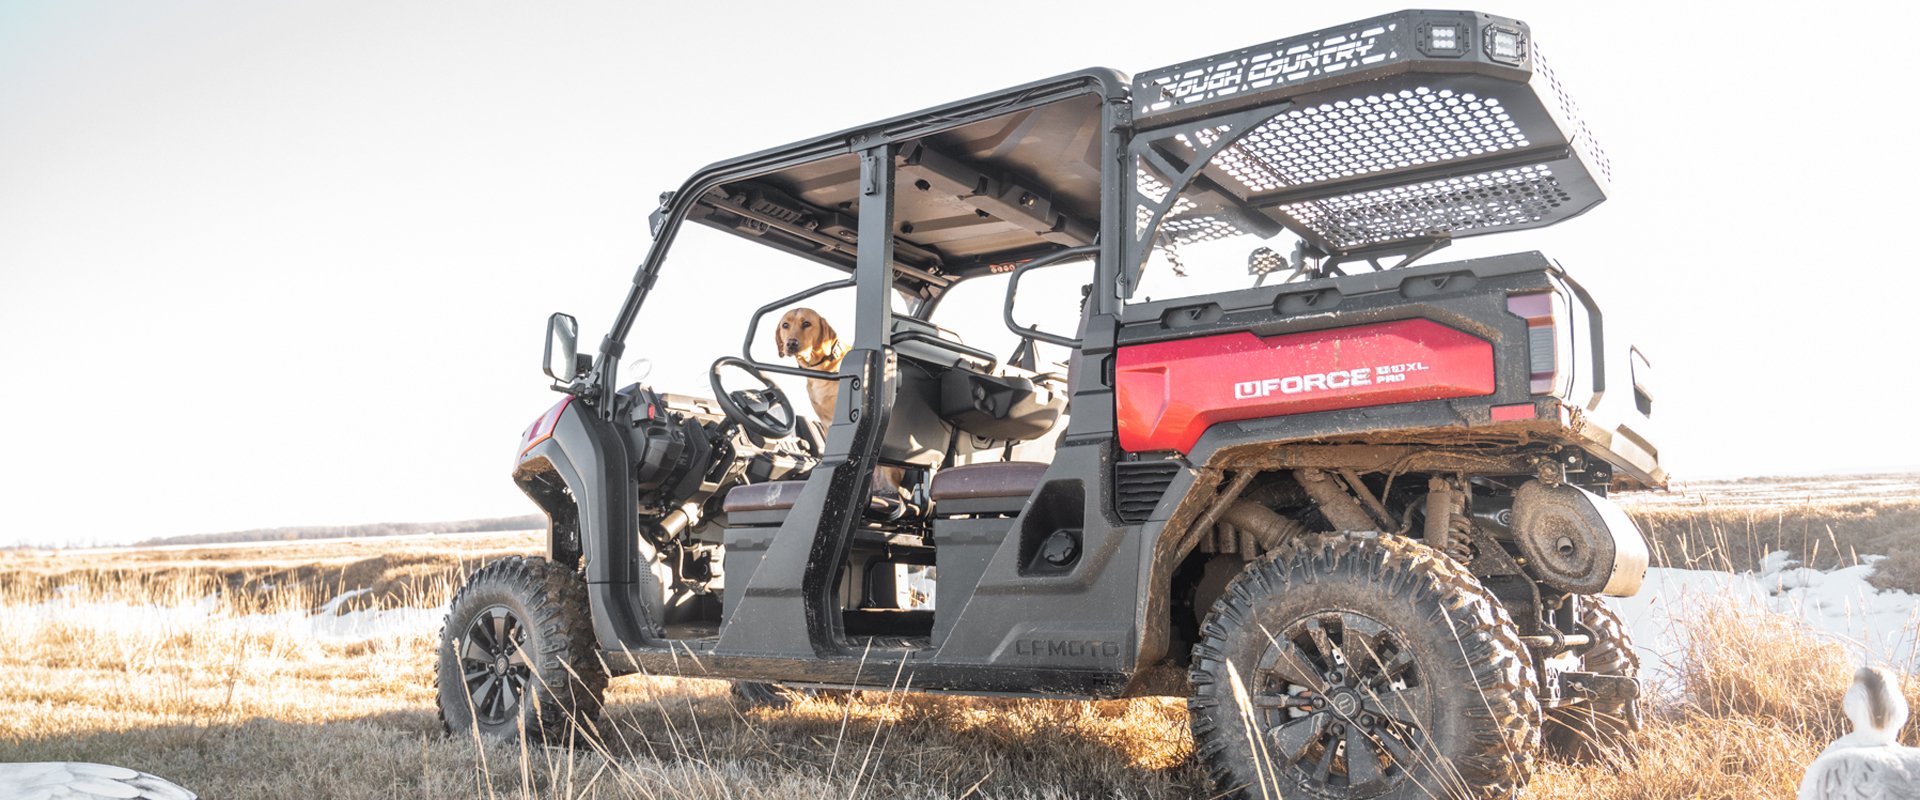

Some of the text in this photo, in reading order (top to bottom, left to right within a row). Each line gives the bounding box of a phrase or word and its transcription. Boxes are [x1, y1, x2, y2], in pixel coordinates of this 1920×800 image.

[1247, 37, 1376, 82] COUNTRY
[1234, 367, 1373, 400] UFORCE
[1375, 373, 1406, 384] PRO
[1015, 640, 1120, 657] CFMOTO
